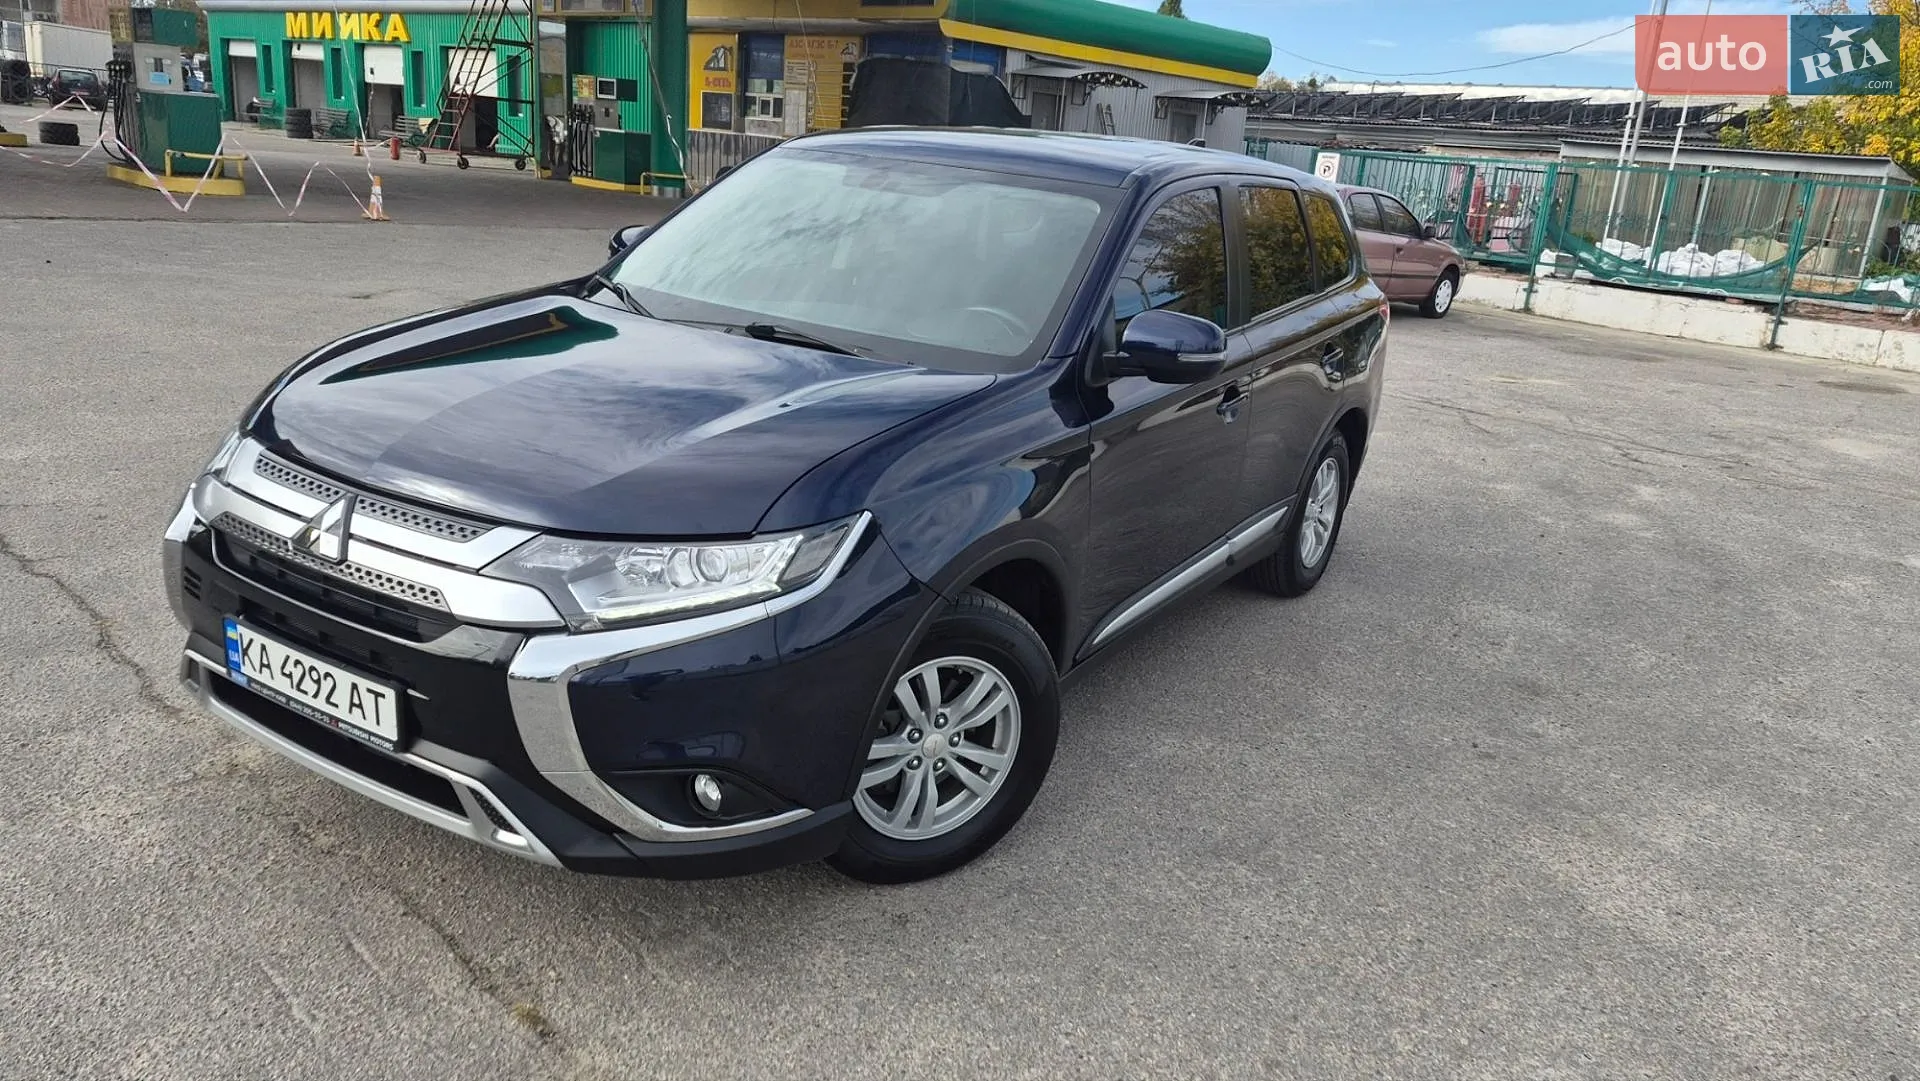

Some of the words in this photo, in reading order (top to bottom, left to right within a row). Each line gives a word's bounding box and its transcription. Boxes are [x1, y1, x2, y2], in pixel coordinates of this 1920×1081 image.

[285, 11, 410, 42] МИЙКА
[240, 632, 275, 681] KA
[280, 654, 339, 709] 4292
[348, 682, 386, 726] AT
